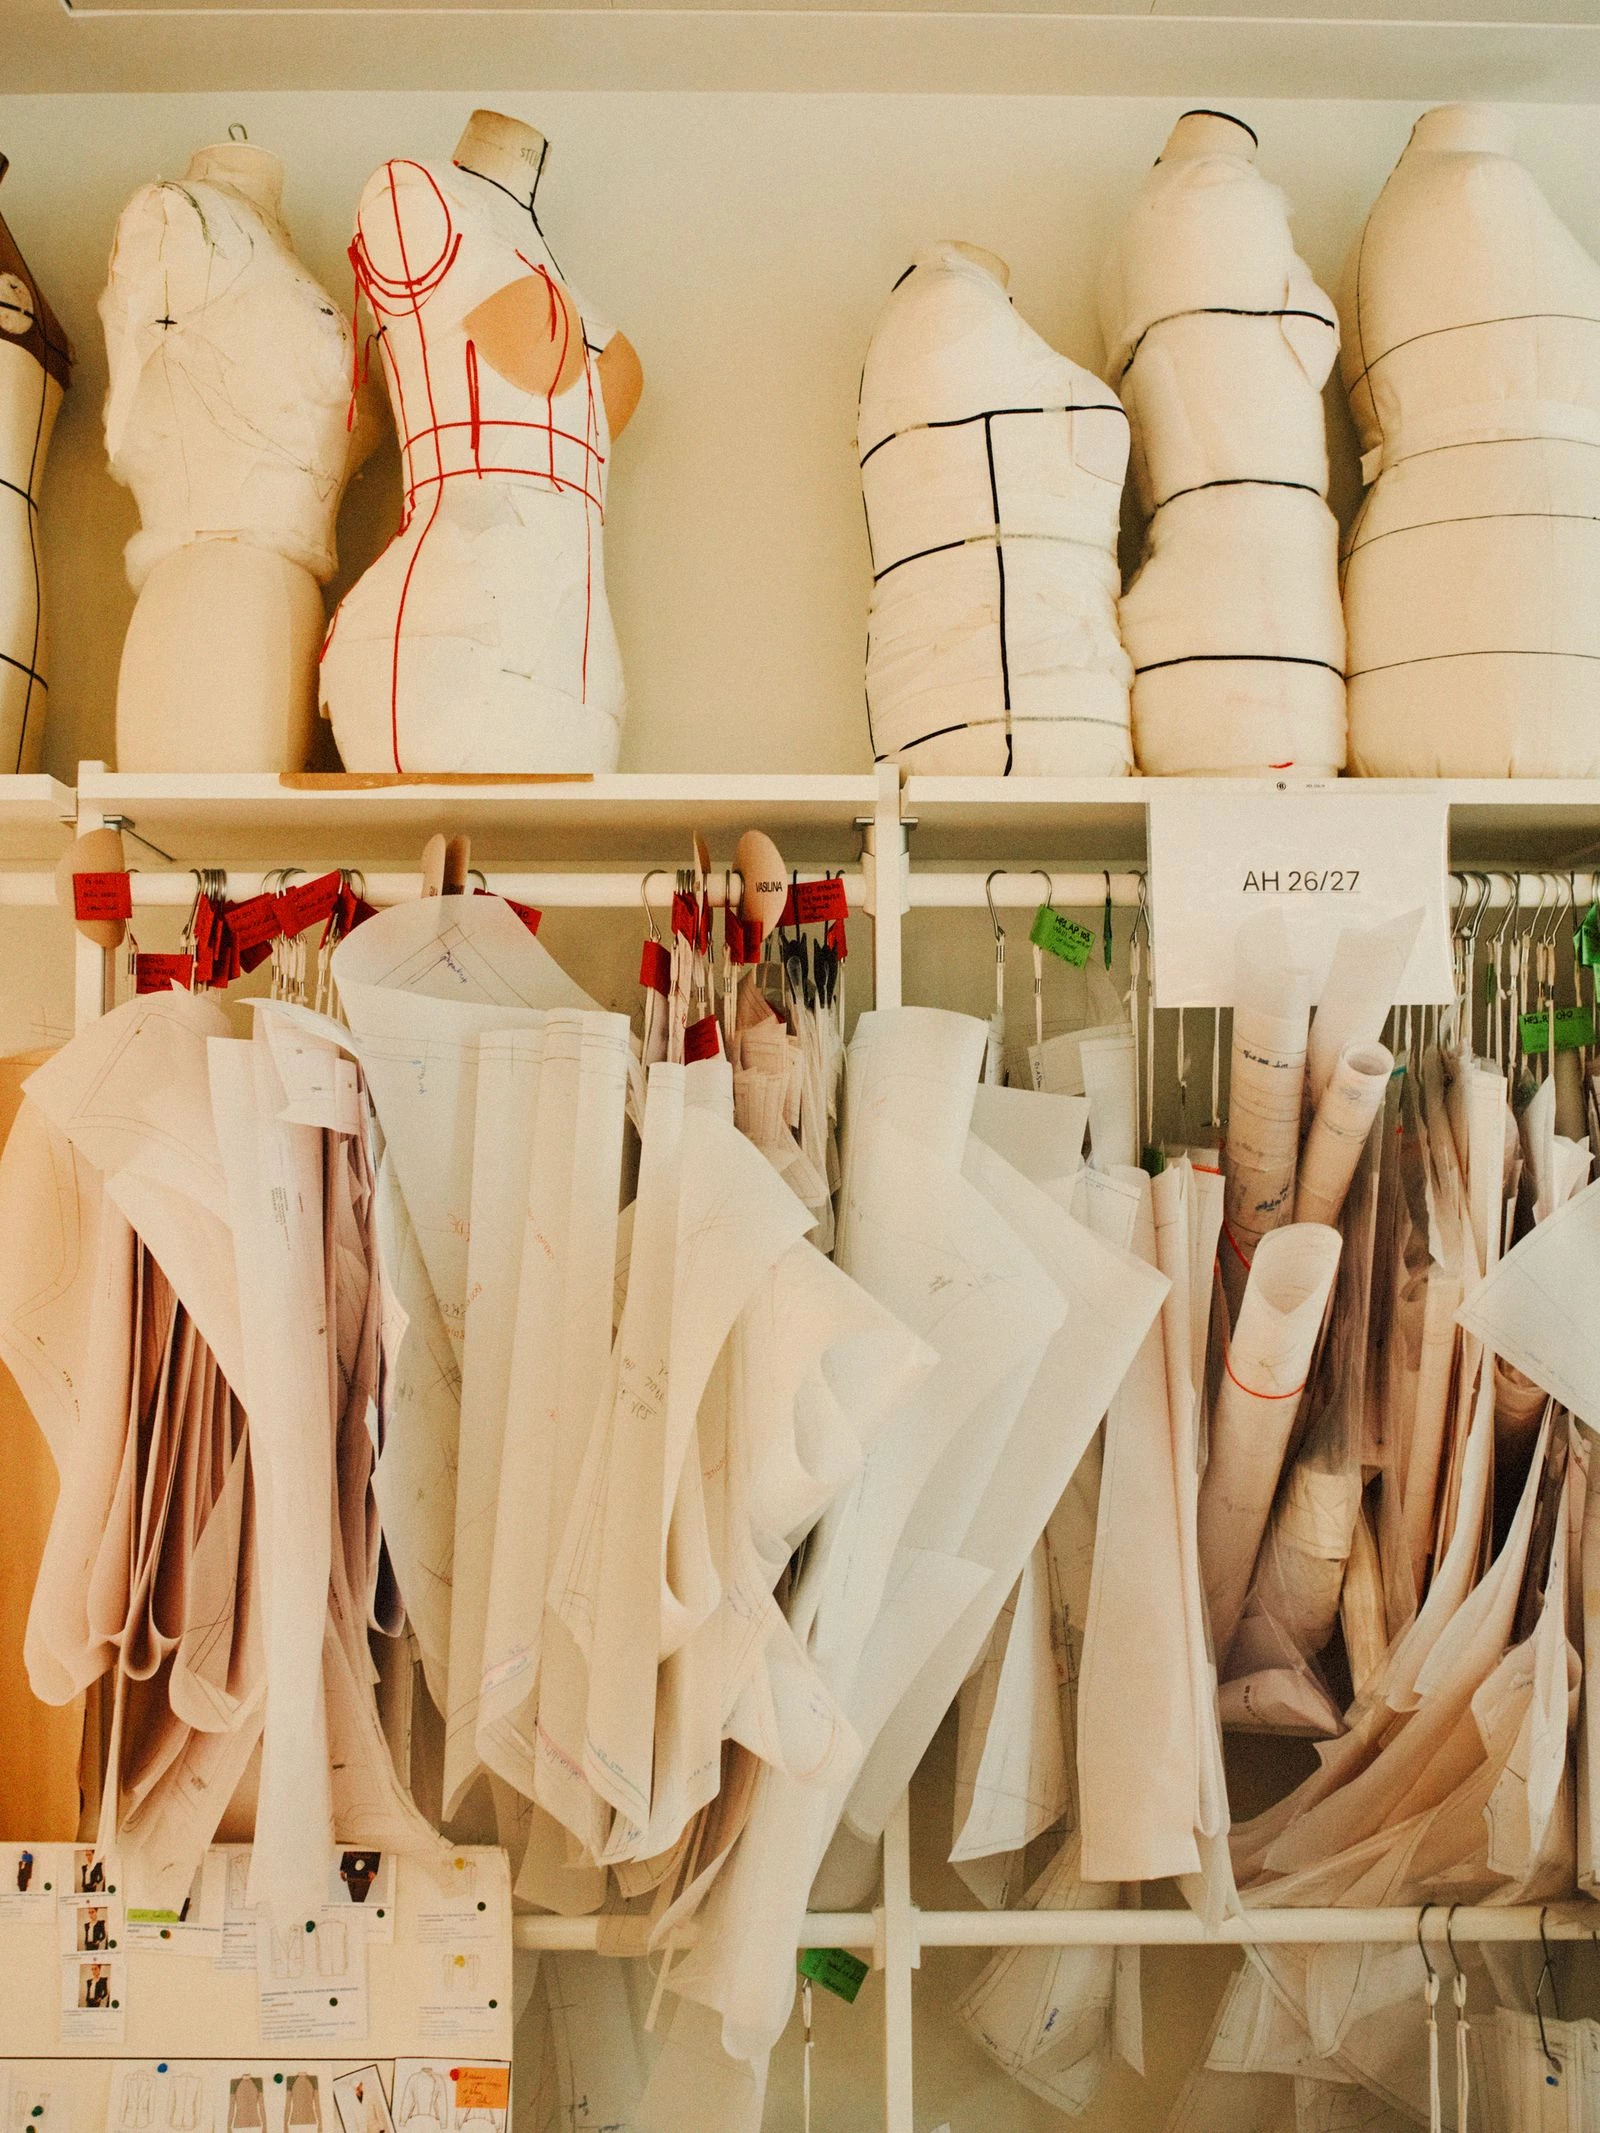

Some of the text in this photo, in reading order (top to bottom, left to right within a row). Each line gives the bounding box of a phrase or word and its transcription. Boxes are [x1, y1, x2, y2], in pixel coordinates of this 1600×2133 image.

[755, 881, 783, 892] VASILINA
[1243, 871, 1360, 891] AH 26/27
